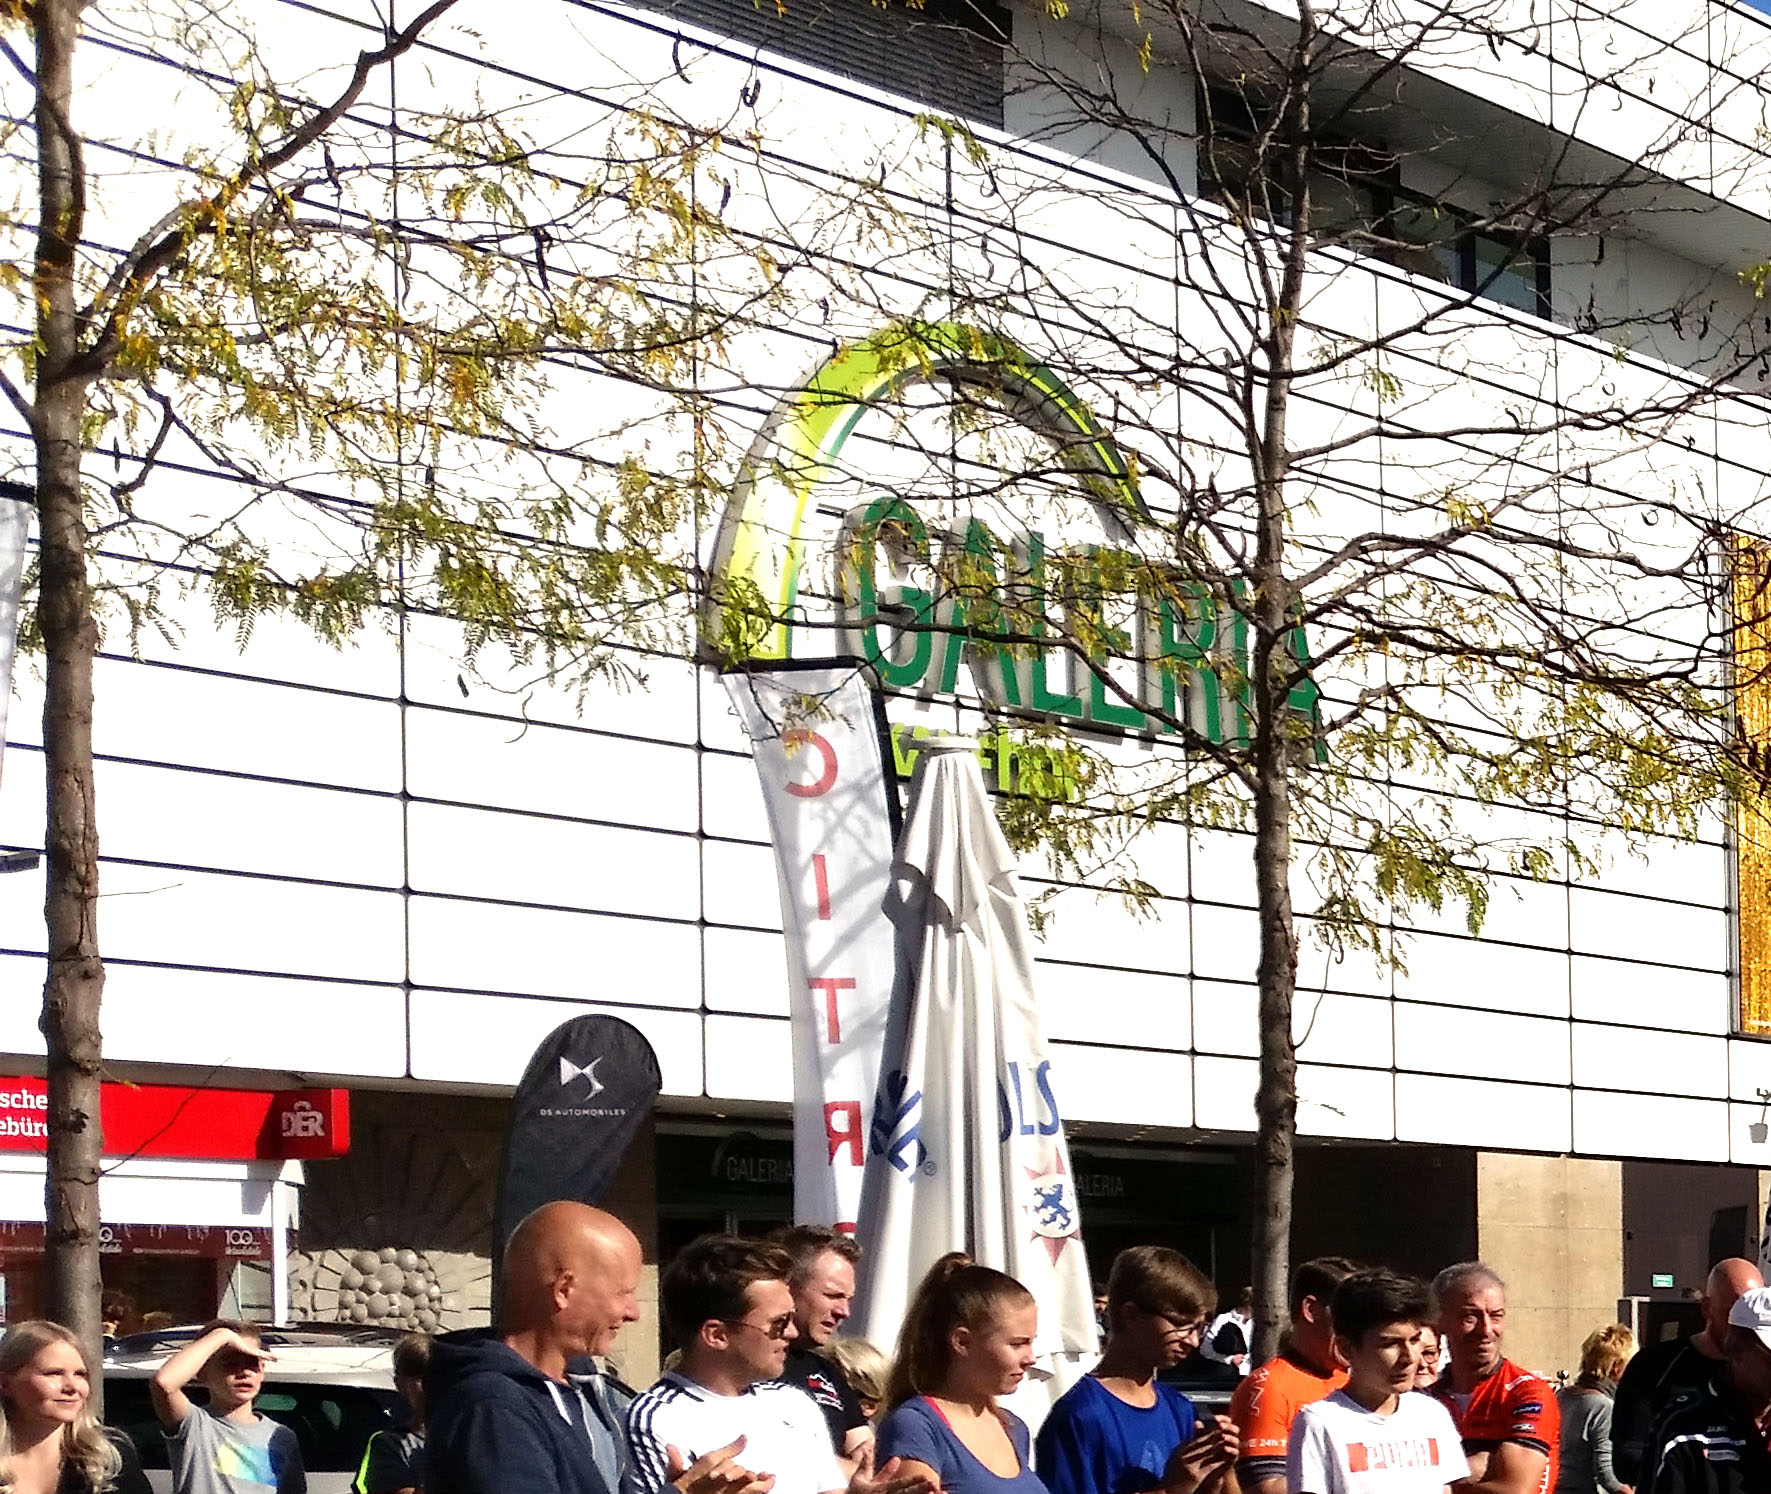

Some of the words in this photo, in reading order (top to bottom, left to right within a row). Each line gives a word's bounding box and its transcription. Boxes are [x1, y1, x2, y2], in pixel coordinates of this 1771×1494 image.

[540, 1108, 552, 1117] DS
[555, 1108, 626, 1117] AUTOMOBILES
[726, 1156, 794, 1183] GALERIA
[1076, 1173, 1126, 1197] ALERIA
[1366, 1437, 1432, 1470] PUMA
